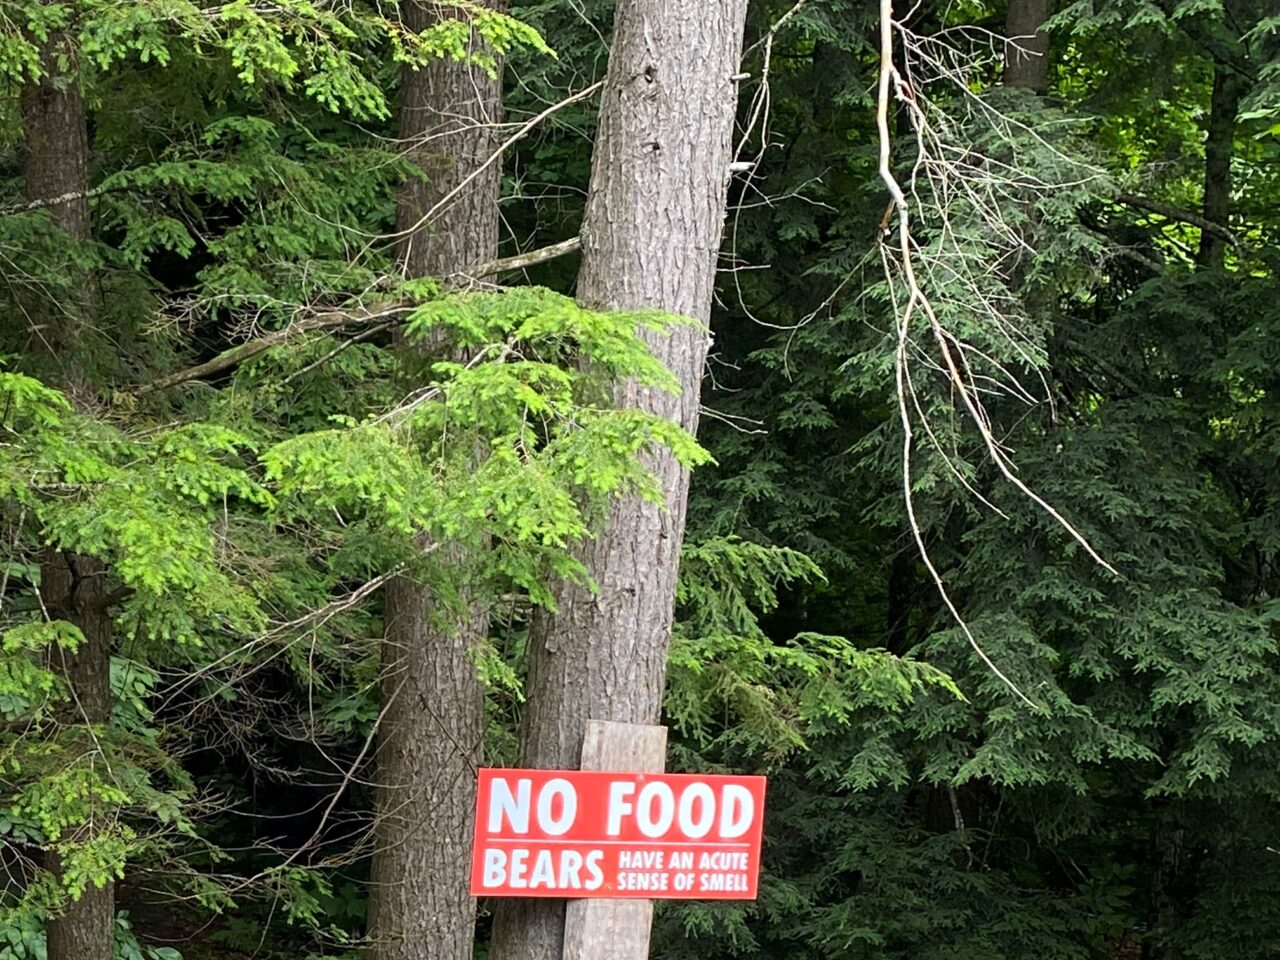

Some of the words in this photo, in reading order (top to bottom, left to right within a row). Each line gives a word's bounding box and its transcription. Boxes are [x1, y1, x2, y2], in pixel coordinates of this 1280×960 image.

[488, 778, 577, 836] NO
[606, 781, 754, 838] FOOD
[483, 849, 603, 890] BEARS
[619, 851, 663, 869] HAVE
[669, 852, 693, 869] AN
[699, 852, 748, 870] ACUTE
[618, 872, 668, 890] SENSE
[674, 872, 695, 890] OF
[700, 873, 748, 891] SMELL
